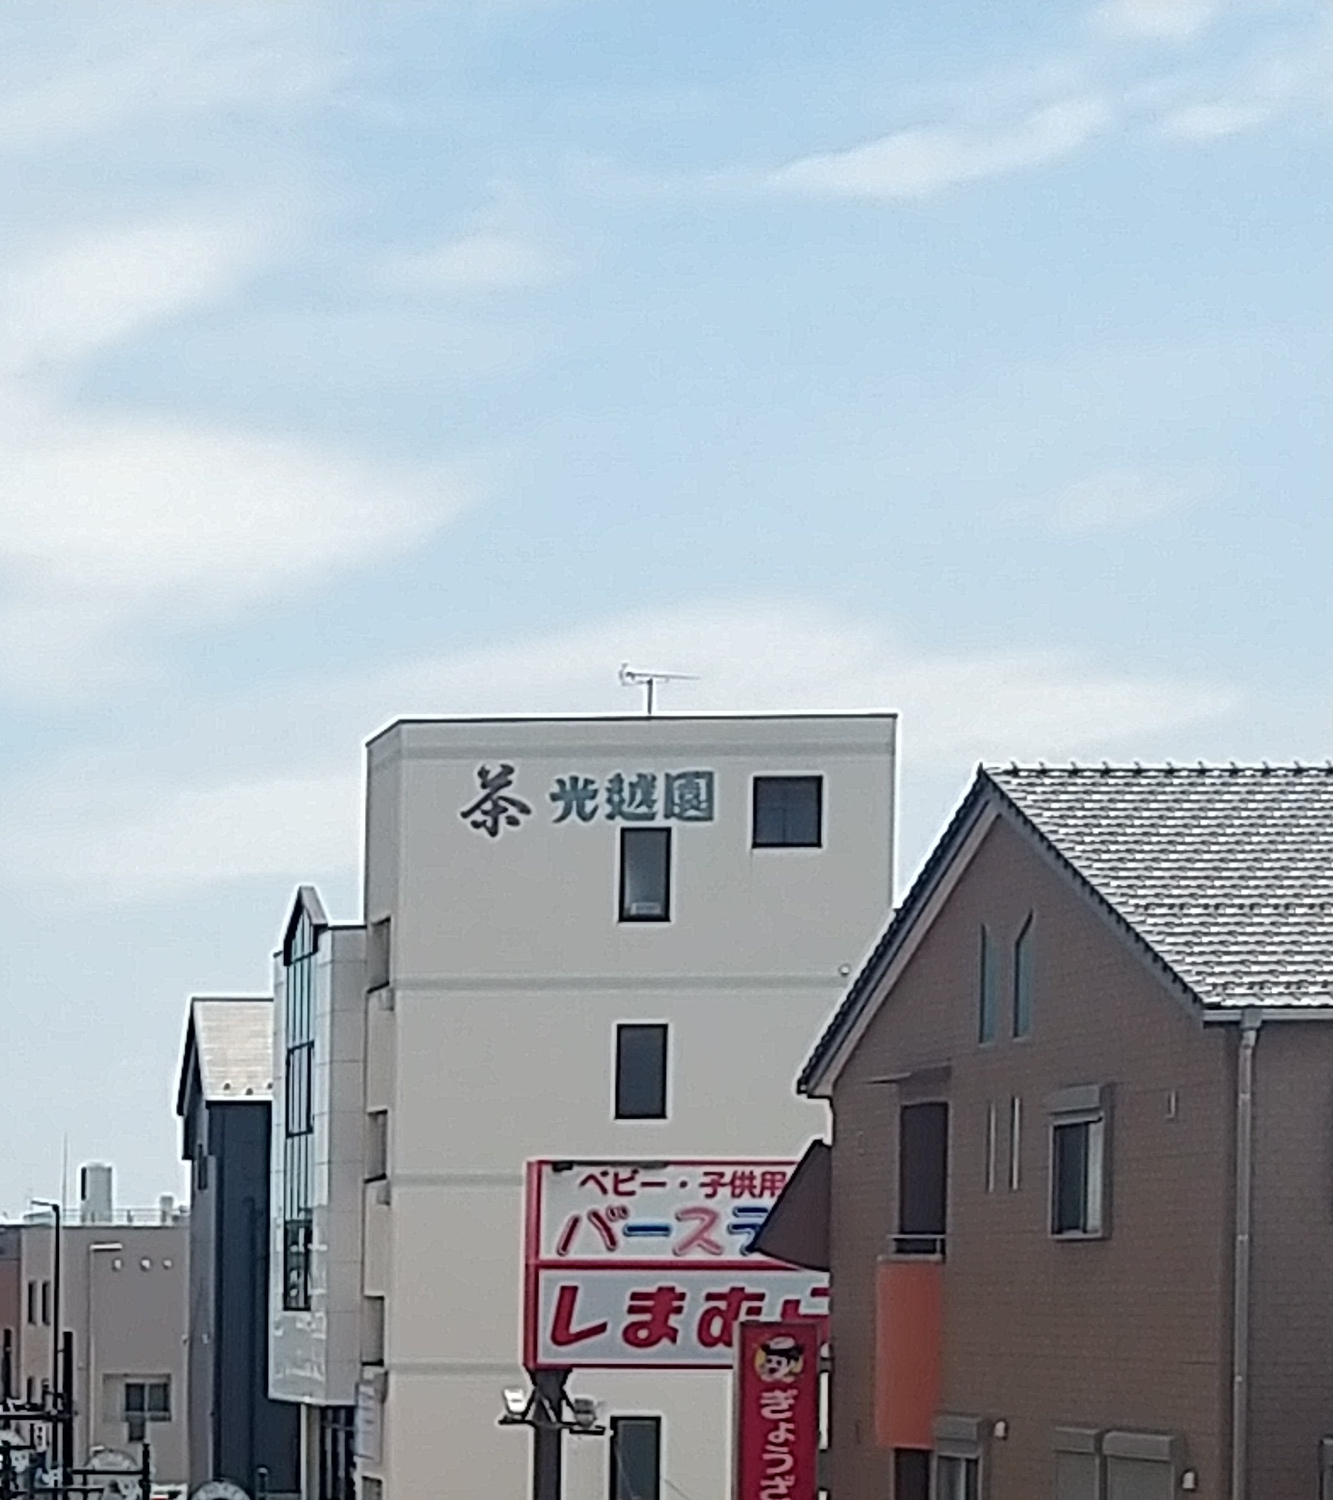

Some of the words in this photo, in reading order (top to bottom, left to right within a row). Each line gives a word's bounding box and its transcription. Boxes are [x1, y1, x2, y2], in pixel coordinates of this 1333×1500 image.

[459, 763, 532, 838] 茶
[549, 768, 715, 823] 光越園
